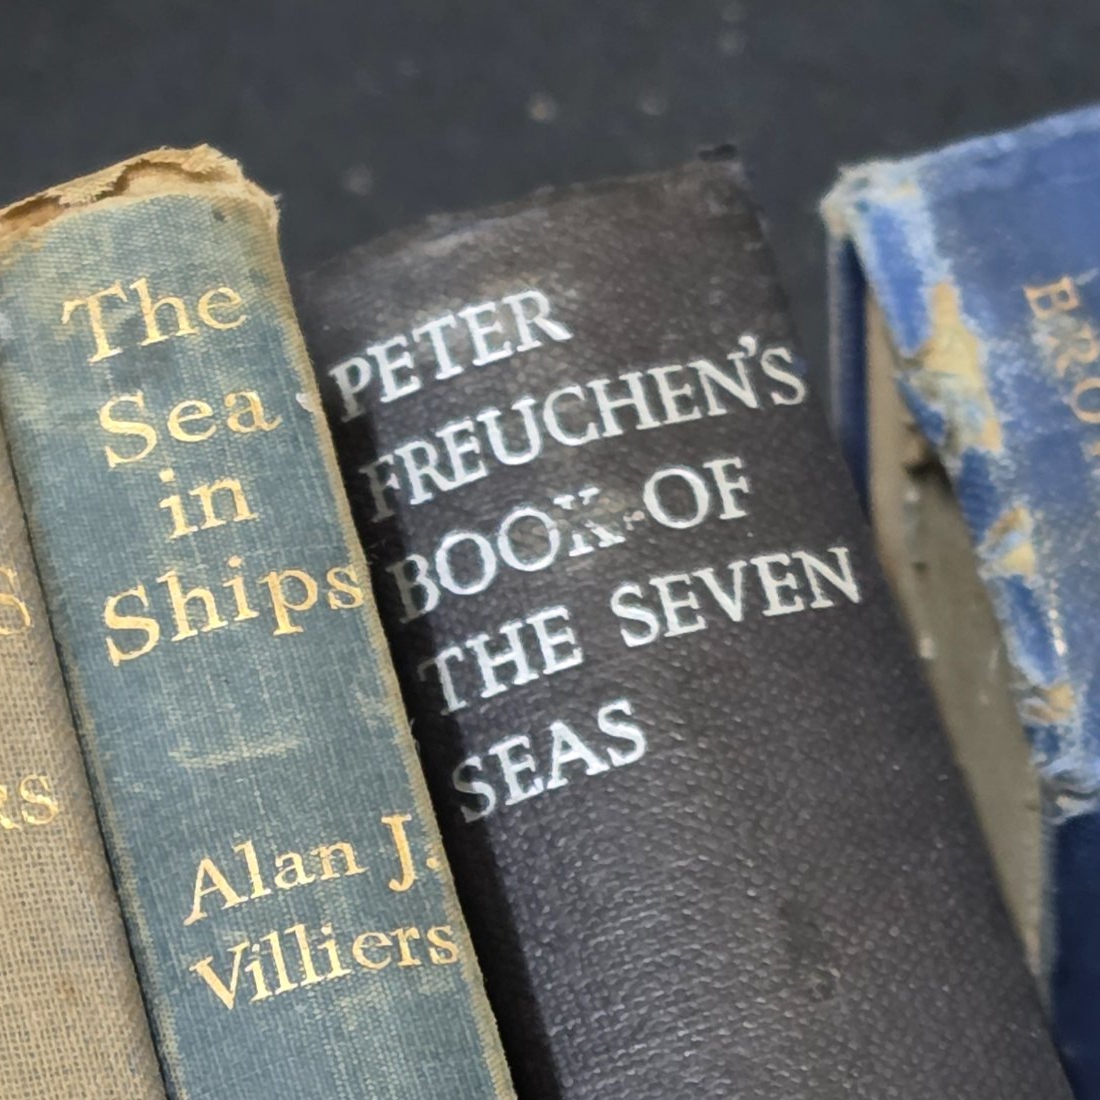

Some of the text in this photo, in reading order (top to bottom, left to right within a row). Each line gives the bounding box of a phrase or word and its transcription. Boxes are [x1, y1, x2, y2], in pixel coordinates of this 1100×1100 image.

[61, 278, 247, 364] The
[328, 289, 573, 424] PETER
[98, 389, 282, 469] Sea
[360, 334, 808, 523] FREUCHEN'S
[159, 468, 259, 540] in
[642, 456, 752, 530] OF
[103, 555, 365, 667] Ships
[418, 545, 860, 718] THE SEVEN
[451, 699, 648, 824] SEAS
[183, 813, 441, 926] Alan J.
[188, 922, 461, 1011] Villiers
